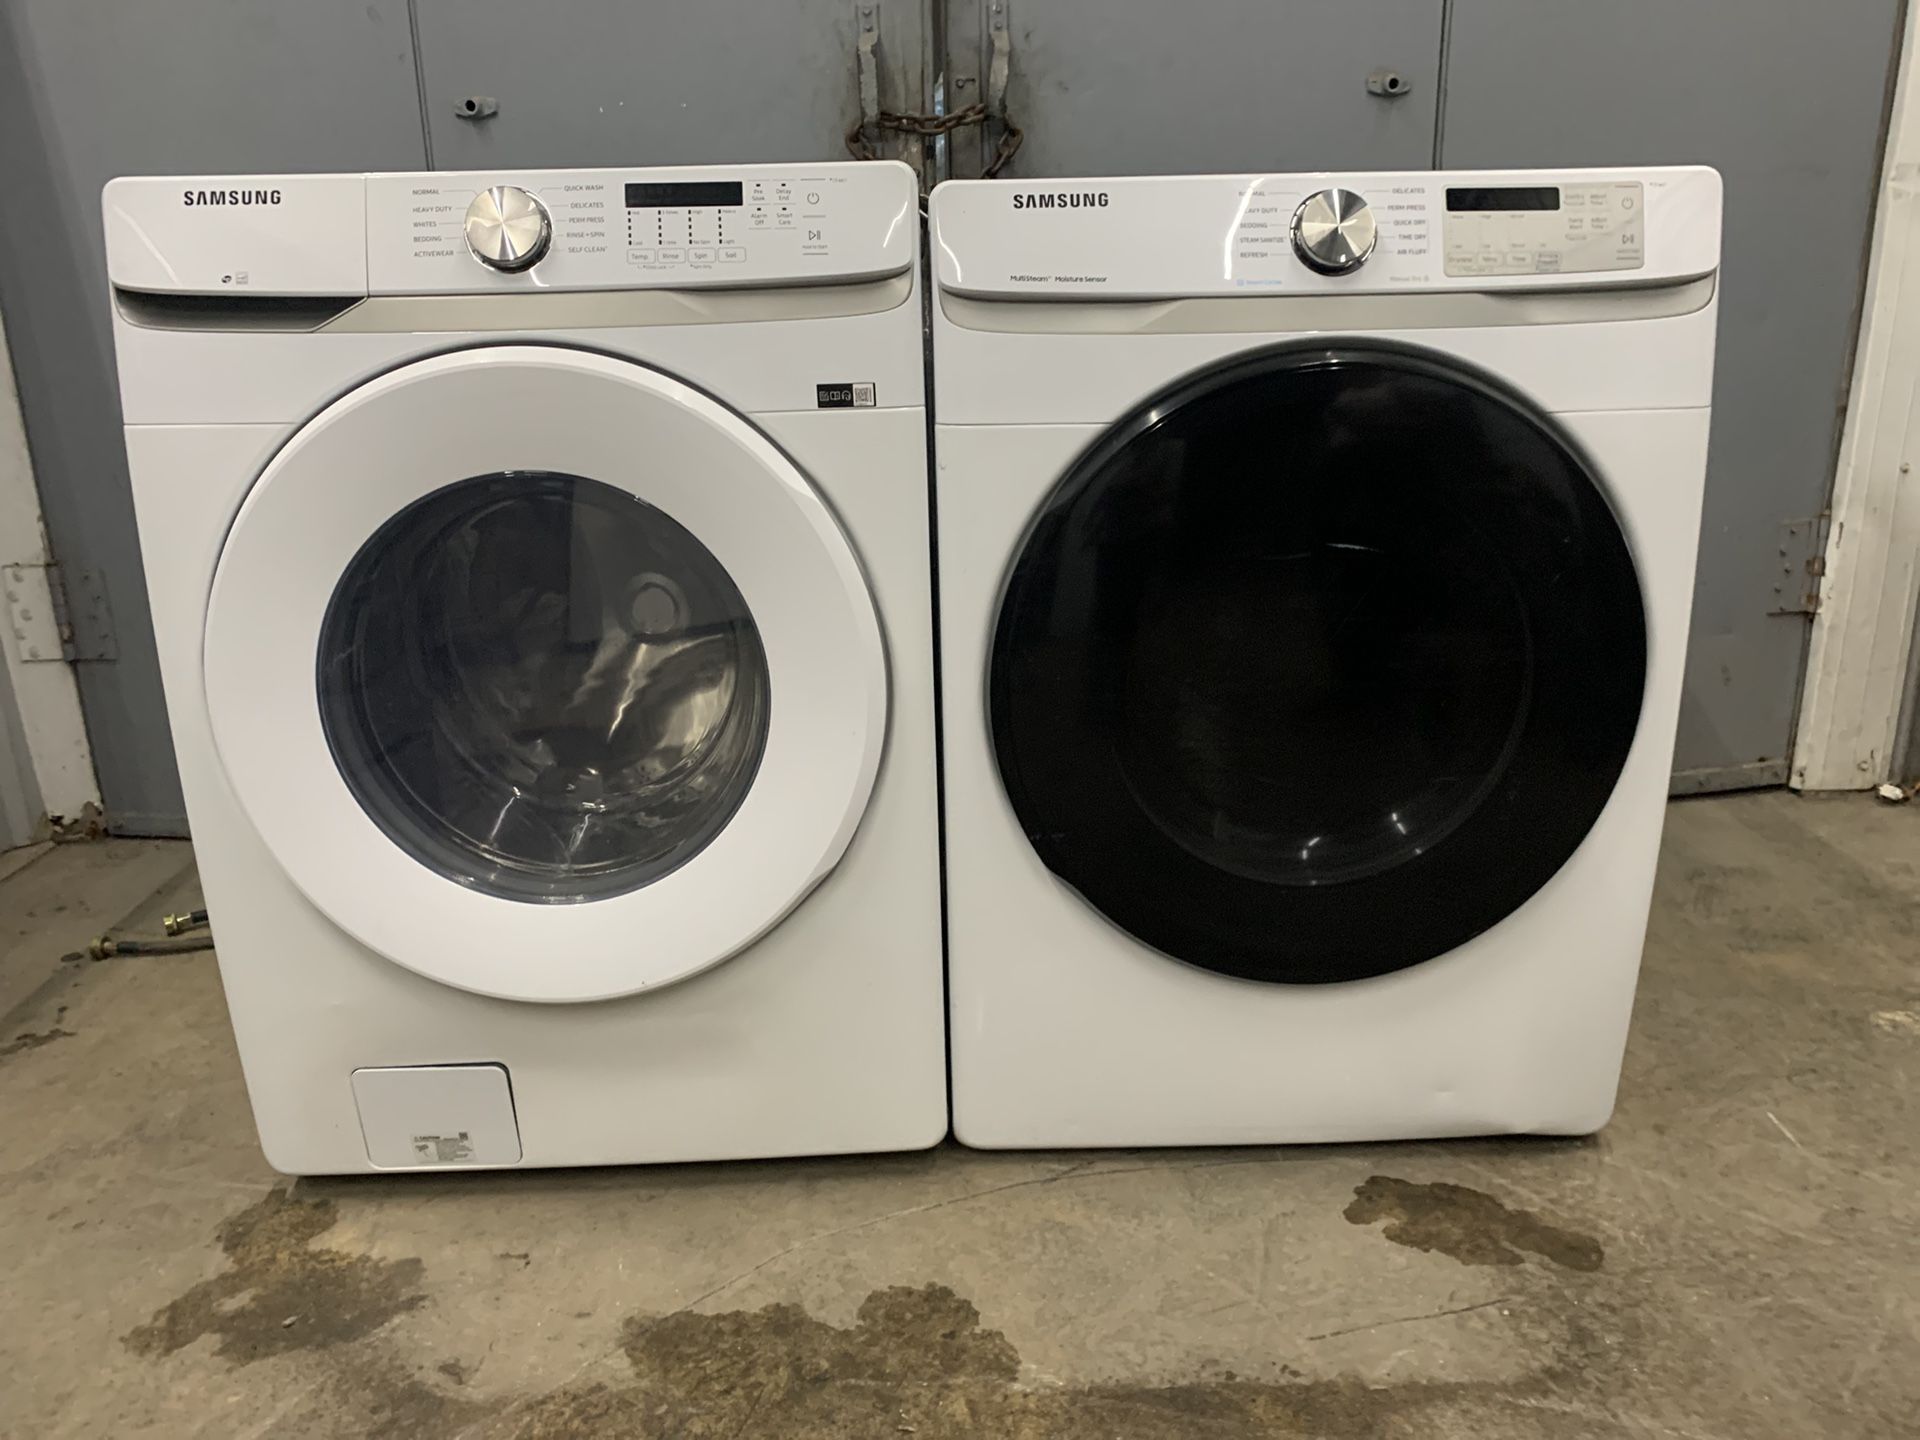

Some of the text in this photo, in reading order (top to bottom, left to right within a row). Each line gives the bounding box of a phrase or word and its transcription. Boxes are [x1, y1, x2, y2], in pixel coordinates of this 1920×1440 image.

[563, 184, 583, 192] QUICK
[184, 189, 282, 206] SAMSUNG
[1012, 192, 1109, 209] SAMSUNG
[434, 205, 453, 213] DUTY
[568, 216, 585, 224] PERM
[413, 235, 442, 243] BEDDING
[694, 252, 708, 260] Spin
